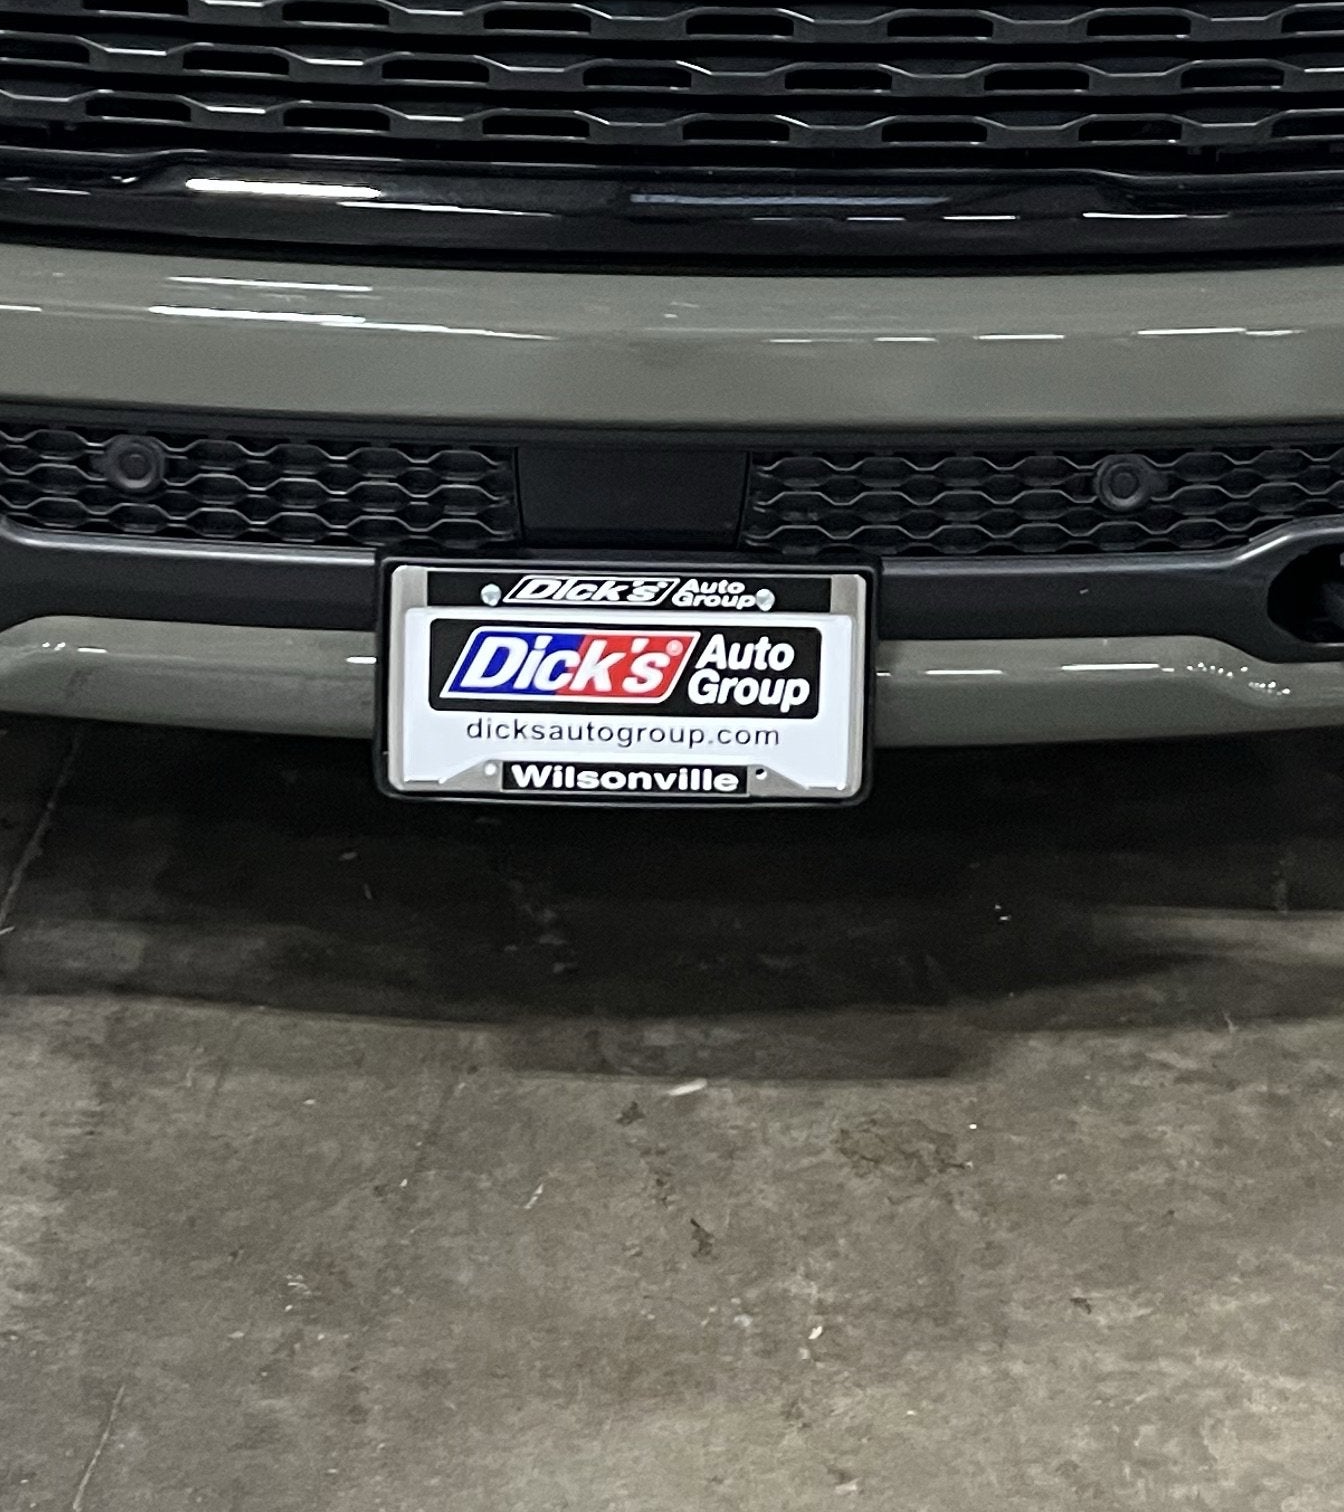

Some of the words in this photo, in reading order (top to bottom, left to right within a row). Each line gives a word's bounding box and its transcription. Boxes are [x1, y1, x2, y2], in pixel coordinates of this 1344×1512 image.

[671, 592, 757, 610] Group
[683, 578, 746, 595] Auto
[695, 633, 796, 672] Auto
[687, 670, 811, 713] Group
[465, 718, 780, 748] dicksautogroup.com
[510, 764, 740, 792] Wilsonville
